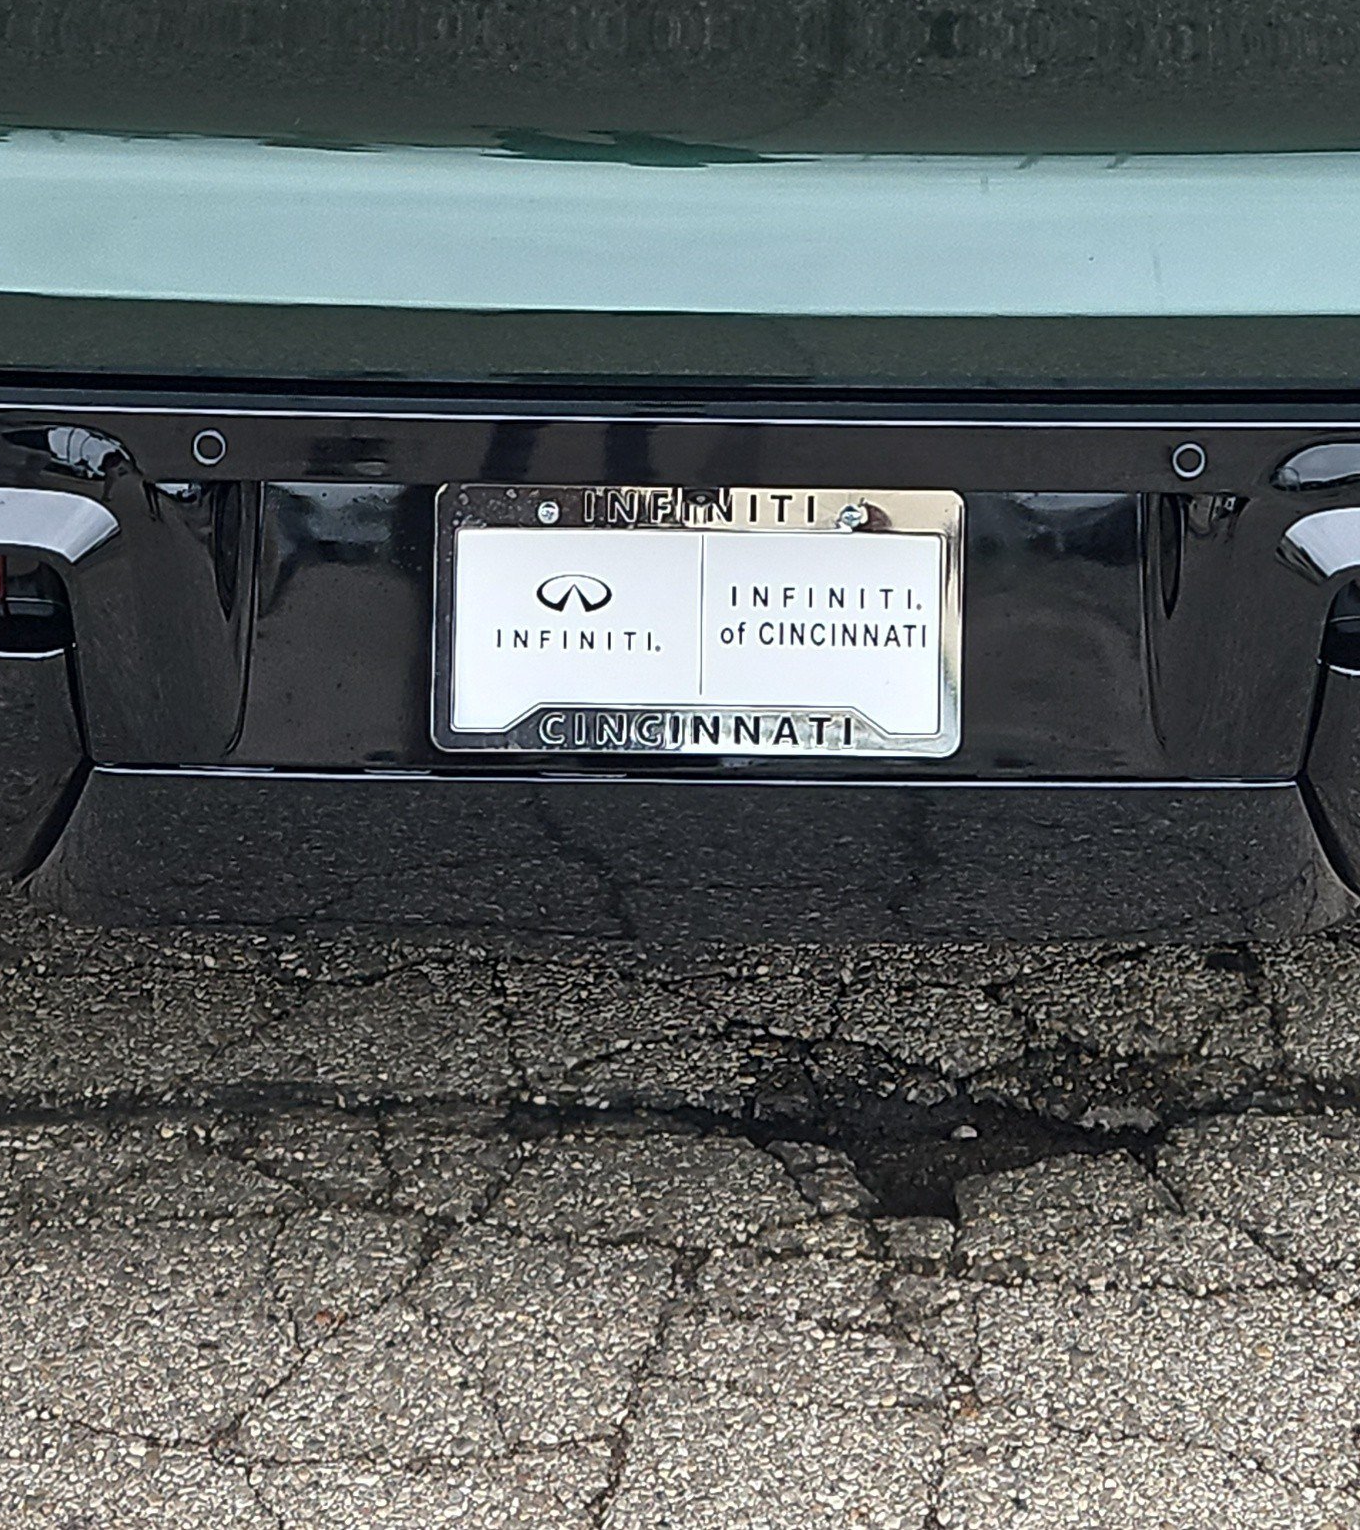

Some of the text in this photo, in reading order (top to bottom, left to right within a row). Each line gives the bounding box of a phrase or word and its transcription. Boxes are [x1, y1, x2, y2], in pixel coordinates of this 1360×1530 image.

[582, 489, 817, 524] INFINITI
[720, 621, 927, 648] of CINCINNATI
[540, 713, 853, 747] CINCINNATI
